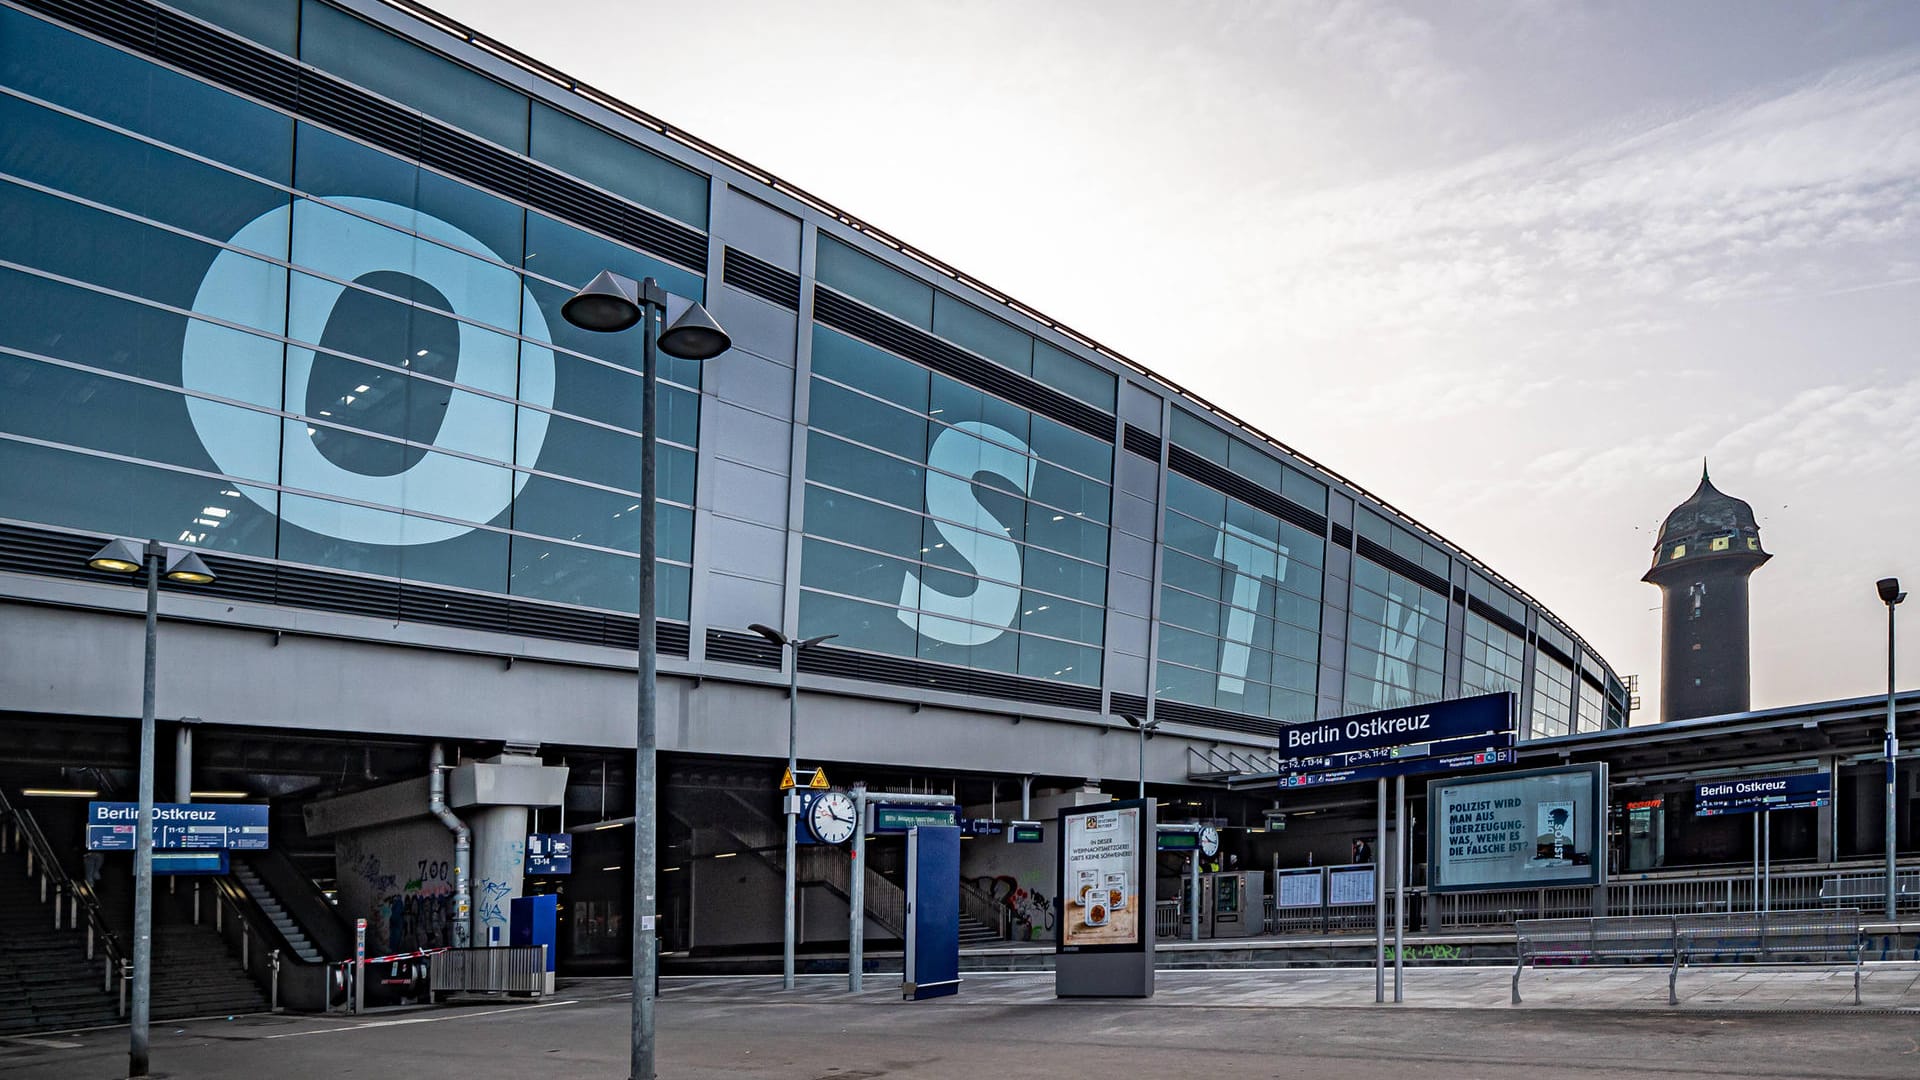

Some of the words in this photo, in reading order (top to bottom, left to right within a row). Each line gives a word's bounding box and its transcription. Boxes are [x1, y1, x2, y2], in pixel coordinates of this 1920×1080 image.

[182, 196, 556, 546] O
[897, 421, 1038, 646] S
[1288, 725, 1339, 748] Berlin
[1345, 713, 1431, 739] Ostkreuz
[1701, 785, 1733, 797] Berlin
[1736, 780, 1786, 793] Ostkreuz
[1449, 800, 1490, 813] POLIZIST
[1494, 797, 1522, 809] WIRD
[151, 807, 216, 820] Ostkreuz
[1449, 813, 1474, 824] MAN
[1475, 811, 1495, 821] AUS
[1449, 835, 1473, 847] WAS,
[1476, 832, 1506, 843] WENN
[1509, 831, 1520, 841] ES
[1449, 846, 1464, 856] DIE
[1466, 843, 1506, 855] FALSCHE
[1508, 841, 1529, 852] IST?
